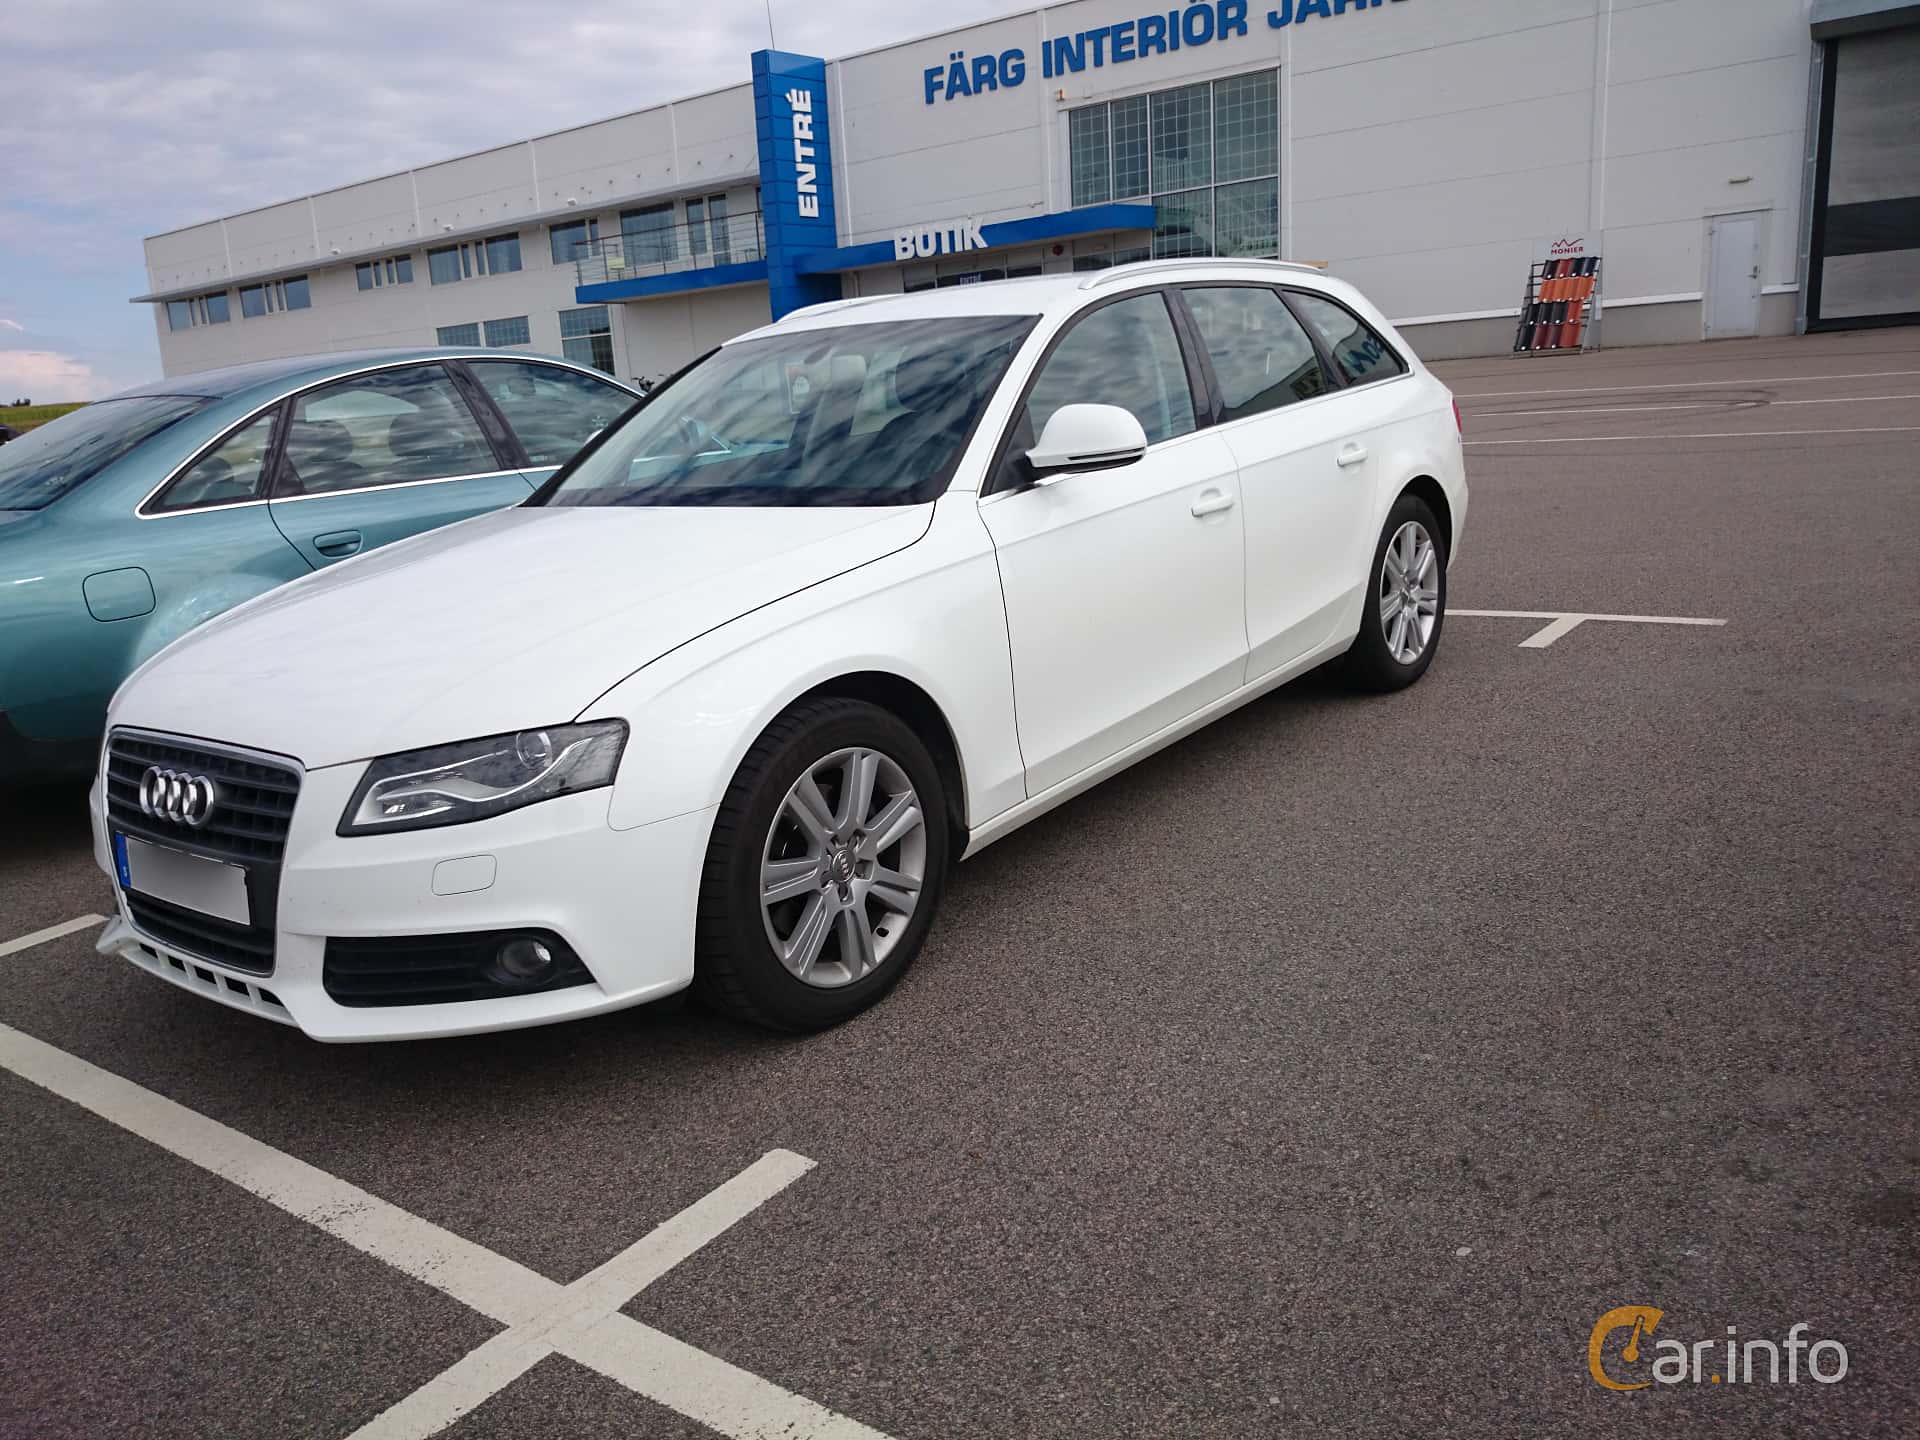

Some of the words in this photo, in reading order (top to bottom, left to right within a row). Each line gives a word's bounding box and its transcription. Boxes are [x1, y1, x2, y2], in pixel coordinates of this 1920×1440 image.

[925, 49, 1025, 104] FÄRG
[1042, 0, 1248, 78] INTERIÖR
[787, 89, 819, 218] ENTRÉ
[894, 216, 989, 260] BUTIK
[1551, 246, 1584, 255] MONIER
